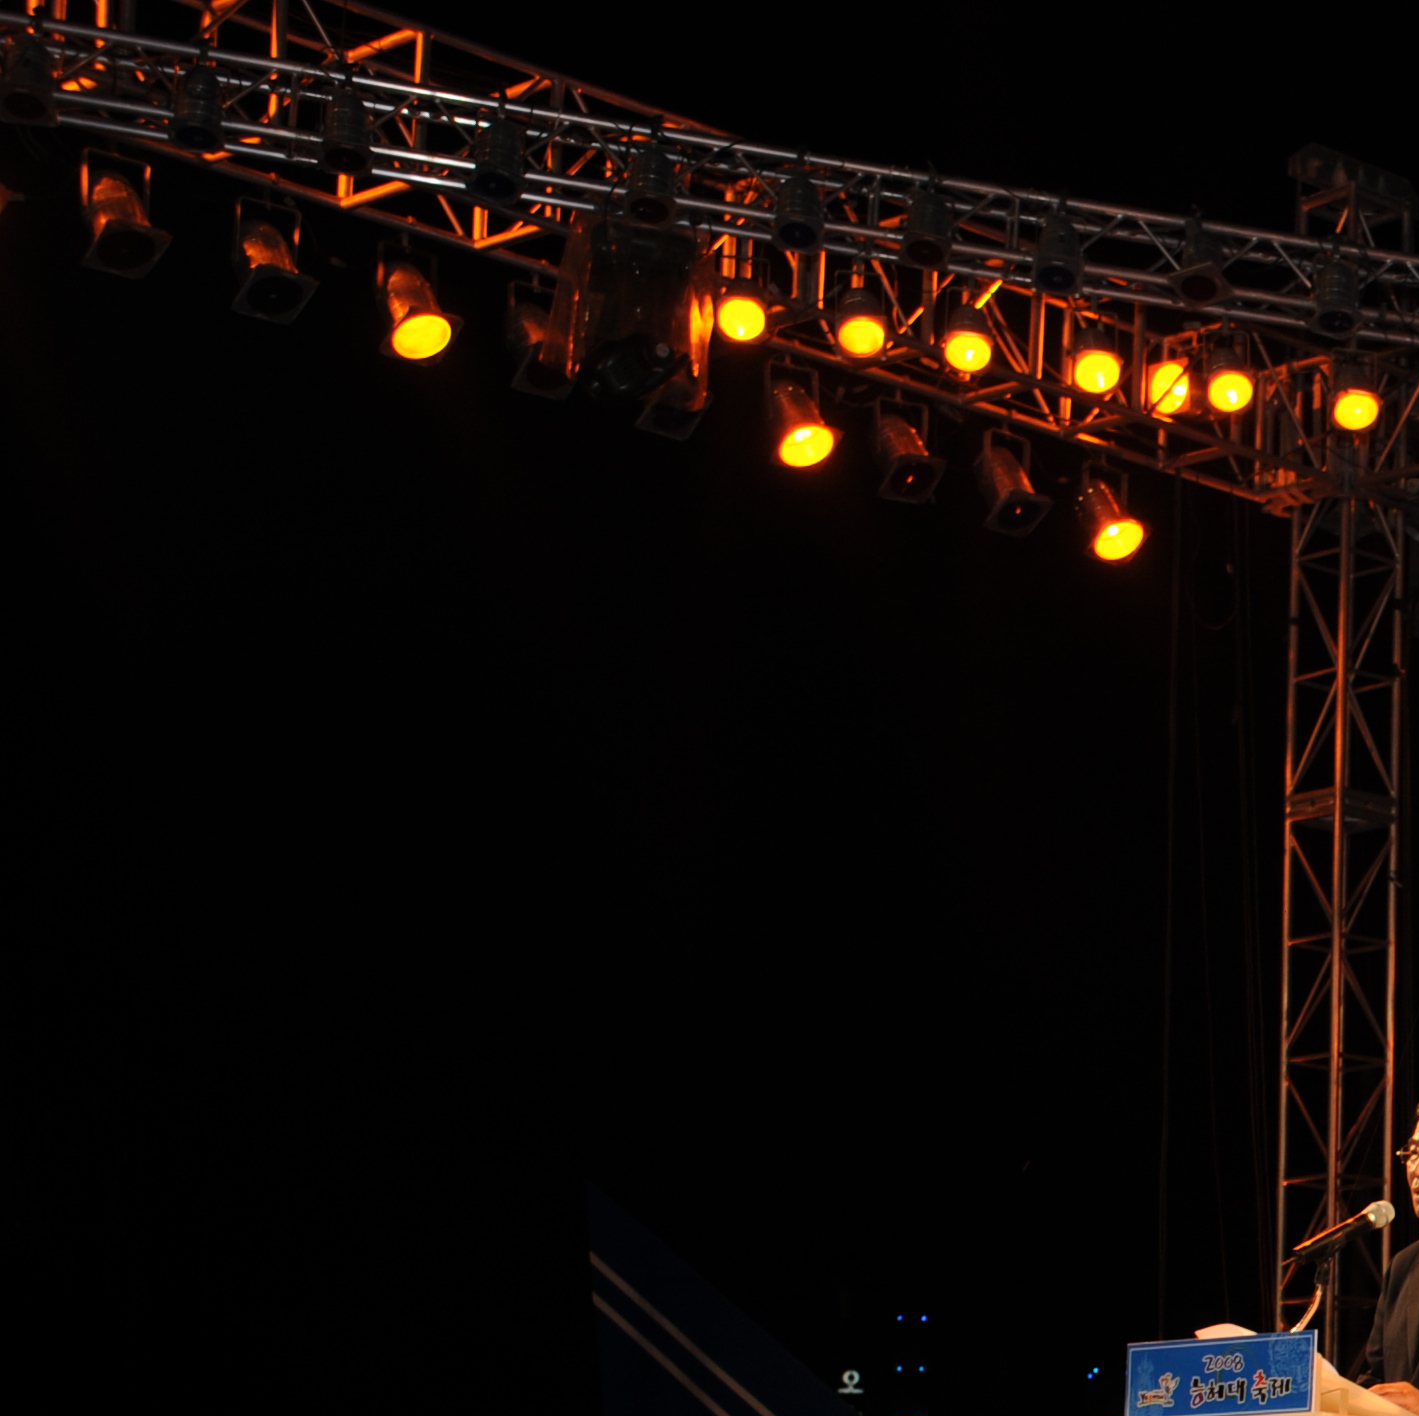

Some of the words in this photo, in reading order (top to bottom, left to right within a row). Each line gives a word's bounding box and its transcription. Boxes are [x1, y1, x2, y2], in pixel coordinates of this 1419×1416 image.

[1203, 1353, 1245, 1373] 2008
[1189, 1376, 1247, 1408] 능허대
[1251, 1369, 1293, 1404] 축제
